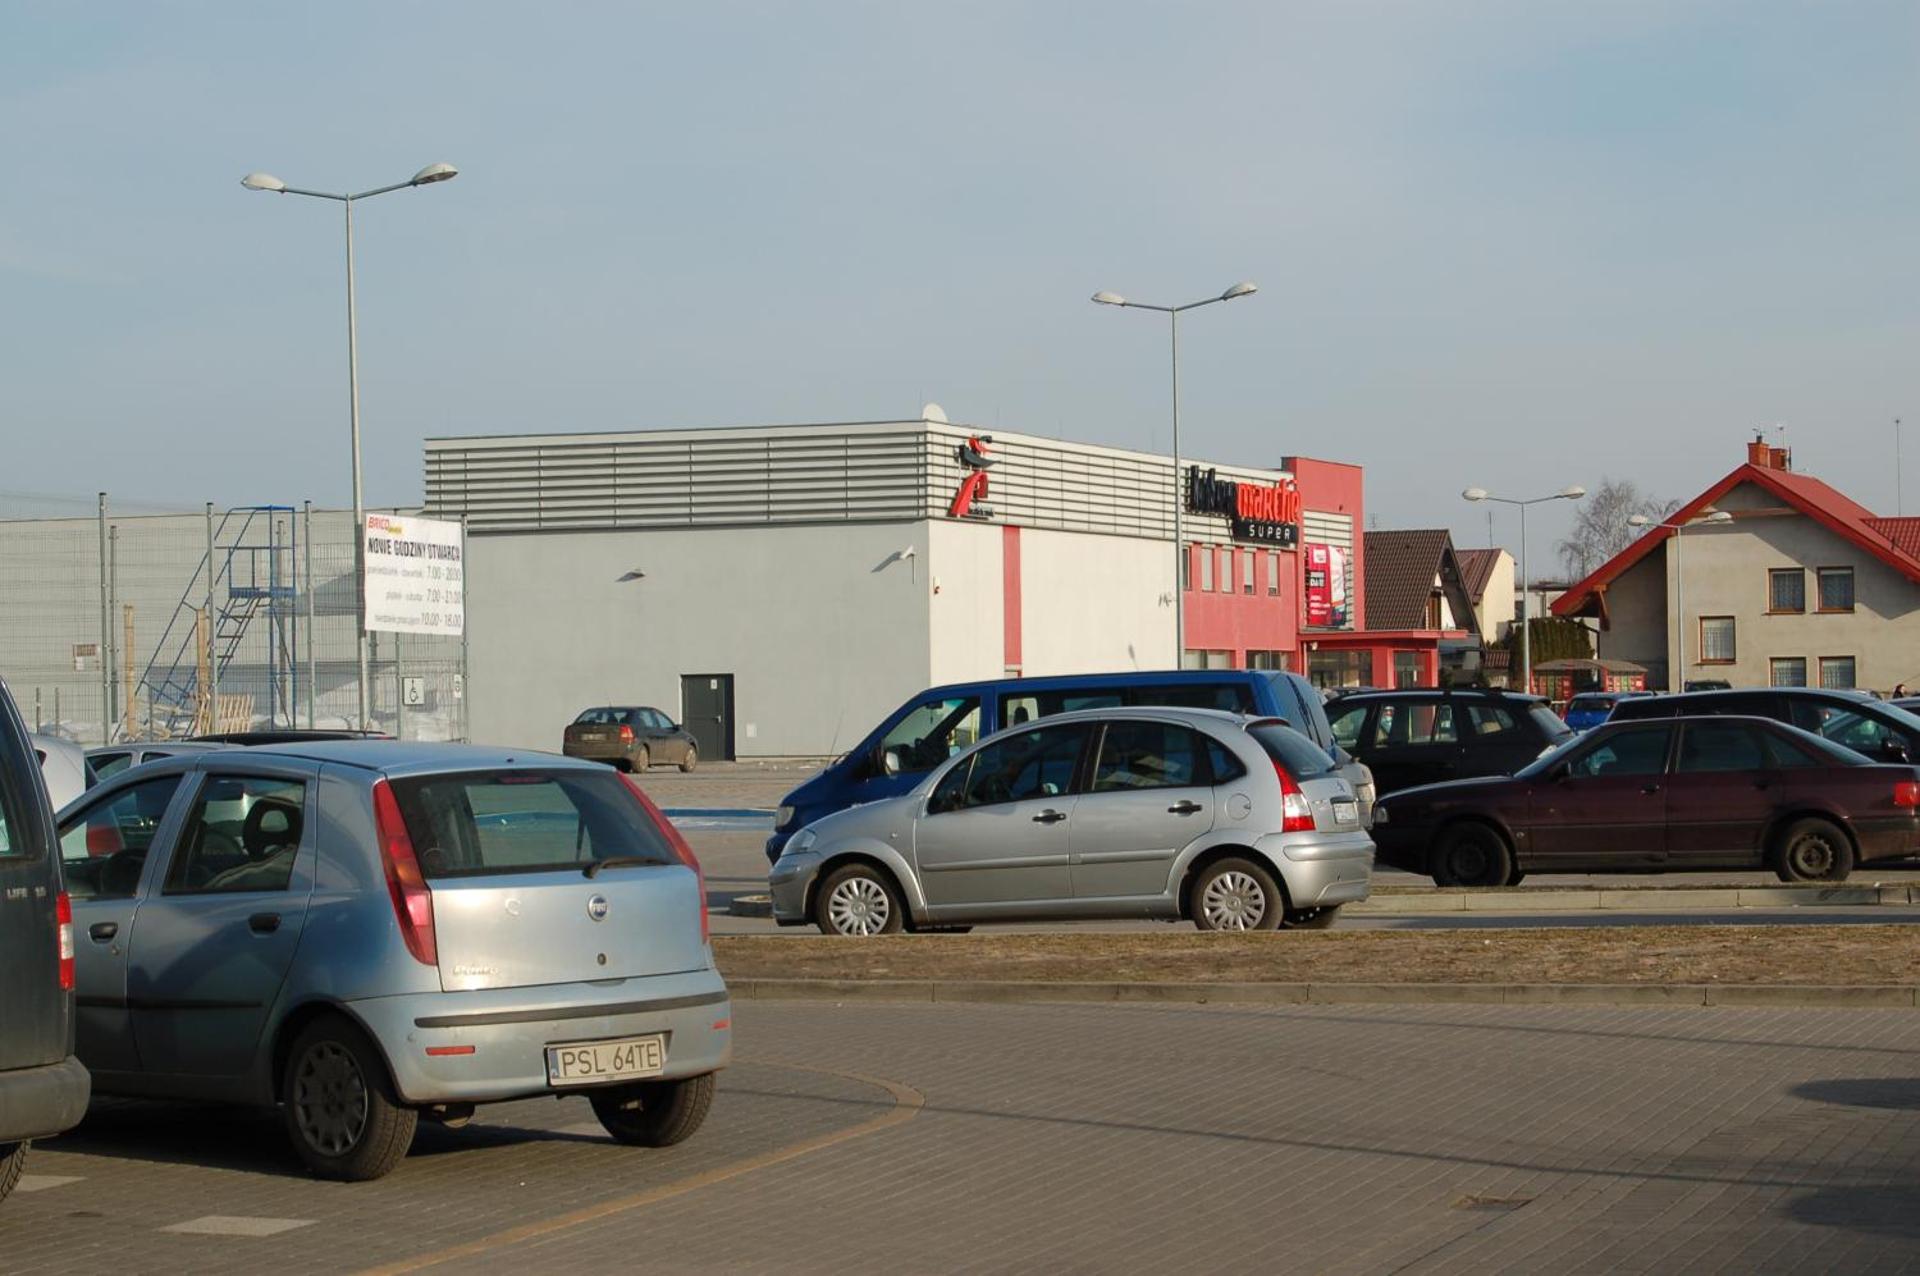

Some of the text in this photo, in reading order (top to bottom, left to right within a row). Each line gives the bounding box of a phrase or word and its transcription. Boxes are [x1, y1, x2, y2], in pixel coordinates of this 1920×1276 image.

[368, 537, 392, 555] NOWE
[394, 540, 426, 558] GODZINY
[562, 1043, 658, 1076] PSL 64TE
